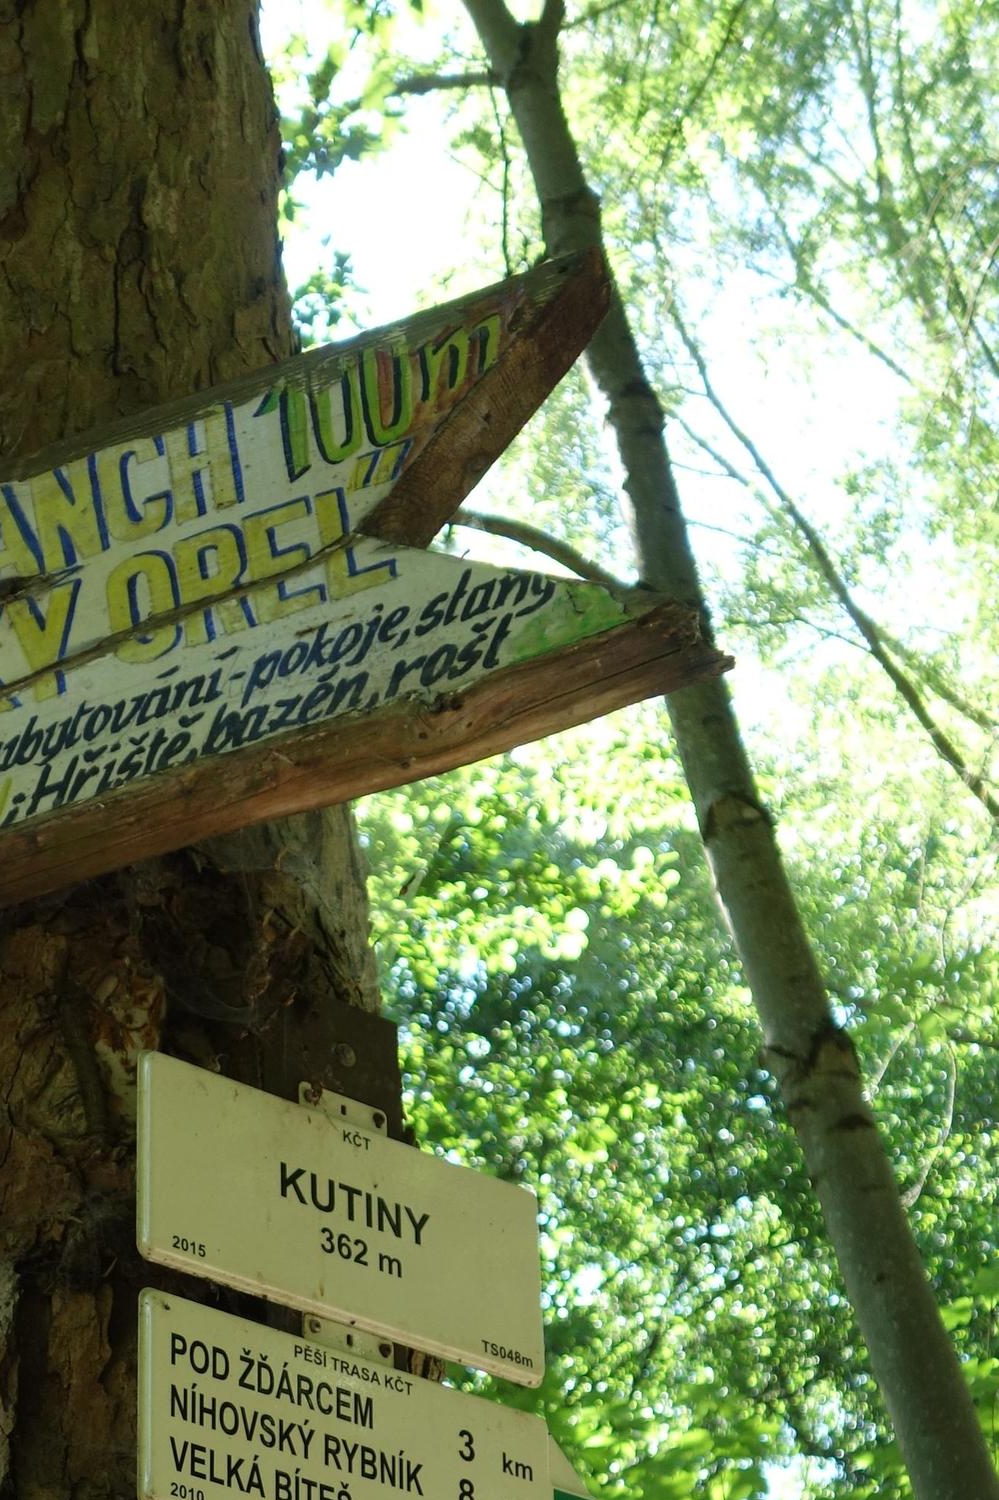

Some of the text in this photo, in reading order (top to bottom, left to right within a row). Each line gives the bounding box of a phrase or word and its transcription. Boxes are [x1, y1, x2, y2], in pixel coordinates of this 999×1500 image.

[343, 1129, 371, 1151] KČT
[280, 1162, 430, 1245] KUTINY
[172, 1235, 206, 1258] 2015
[321, 1227, 403, 1278] 362 m
[294, 1343, 413, 1395] PĚŠÍ TRASA KČT
[481, 1340, 533, 1368] TS048m
[170, 1332, 534, 1483] POD ŽĎÁRCEM 3 km
[169, 1382, 315, 1460] NÍHOVSKÝ
[324, 1434, 424, 1497] RYBNÍK
[169, 1436, 265, 1500] VELKÁ
